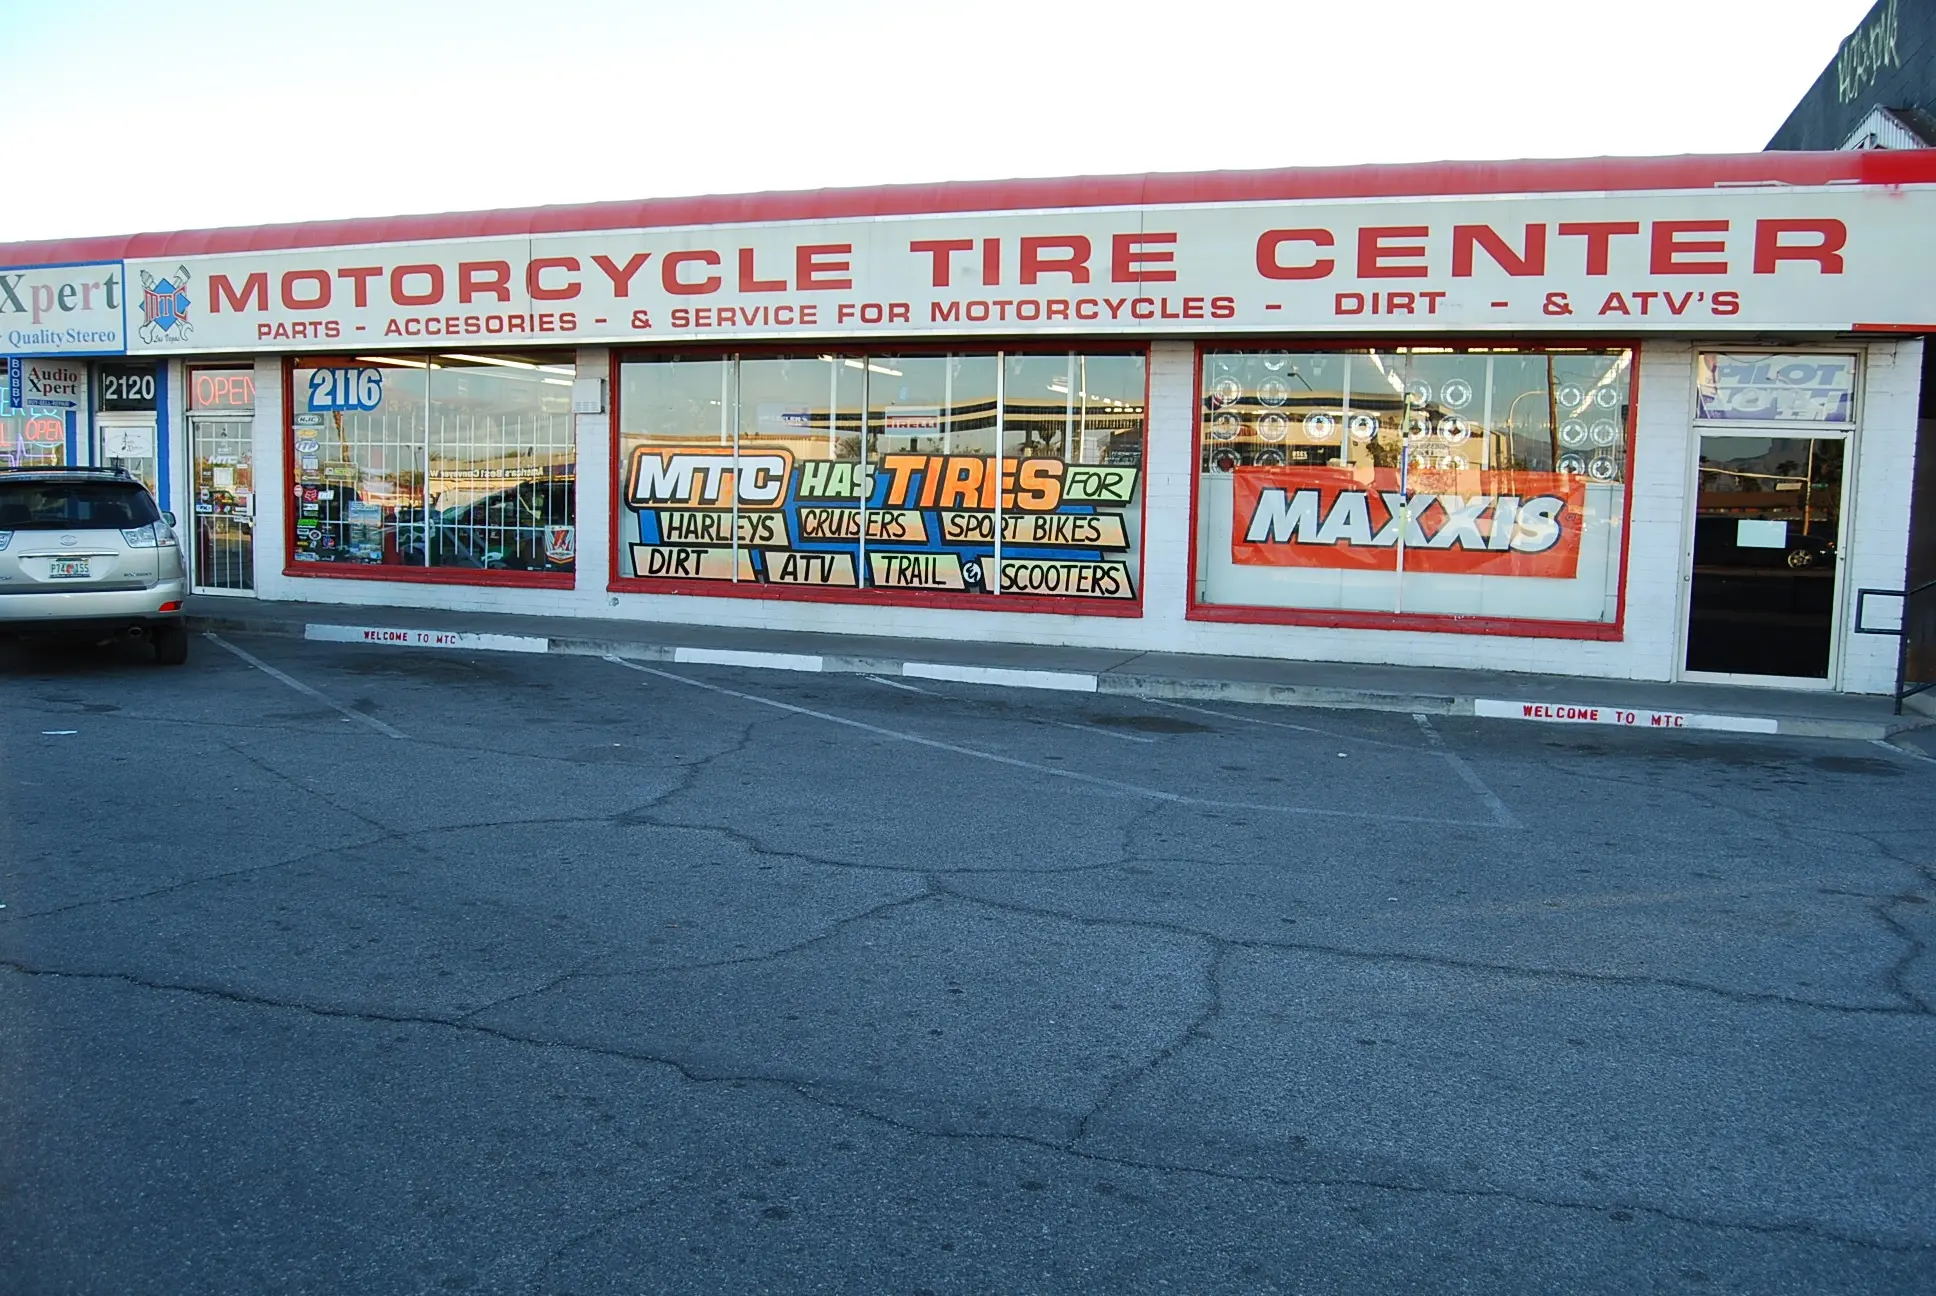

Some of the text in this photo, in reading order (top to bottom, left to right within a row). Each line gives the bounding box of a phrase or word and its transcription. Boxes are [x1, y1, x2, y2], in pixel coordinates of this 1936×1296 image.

[208, 218, 1847, 314] MOTORCYCLE TIRE CENTER
[0, 272, 120, 325] Xpert
[143, 284, 188, 325] MTC
[257, 319, 341, 341] PARTS
[384, 312, 578, 337] ACCESORIES
[631, 310, 652, 329] &
[671, 304, 818, 328] SERVICE
[837, 302, 911, 325] FOR
[930, 296, 1236, 322] MOTORCYCLES
[1335, 291, 1447, 315] DIRT
[1542, 292, 1573, 315] &
[1598, 291, 1740, 315] ATV'S
[8, 327, 116, 348] Quality Stereo
[11, 359, 21, 407] BOBBY
[28, 367, 78, 382] Audio
[28, 378, 77, 396] Xpert
[105, 375, 155, 399] 2120
[198, 375, 256, 406] OPEN
[309, 368, 382, 410] 2116
[1717, 363, 1847, 386] PILOT
[25, 419, 64, 442] OPEN
[886, 415, 938, 429] PIRELLI
[636, 455, 1123, 512] MTC HAS TIRES FOR
[666, 508, 1101, 543] HARLEYS CRUISERS SPORT BIKES
[1245, 486, 1565, 554] MAXXIS
[648, 548, 709, 577] DIRT
[779, 554, 836, 583] ATV
[881, 555, 947, 587] TRAIL
[1000, 562, 1121, 596] SCOOTERS
[364, 630, 456, 644] WELCOME TO MTC
[1522, 704, 1684, 727] WELCOME TO MTC
